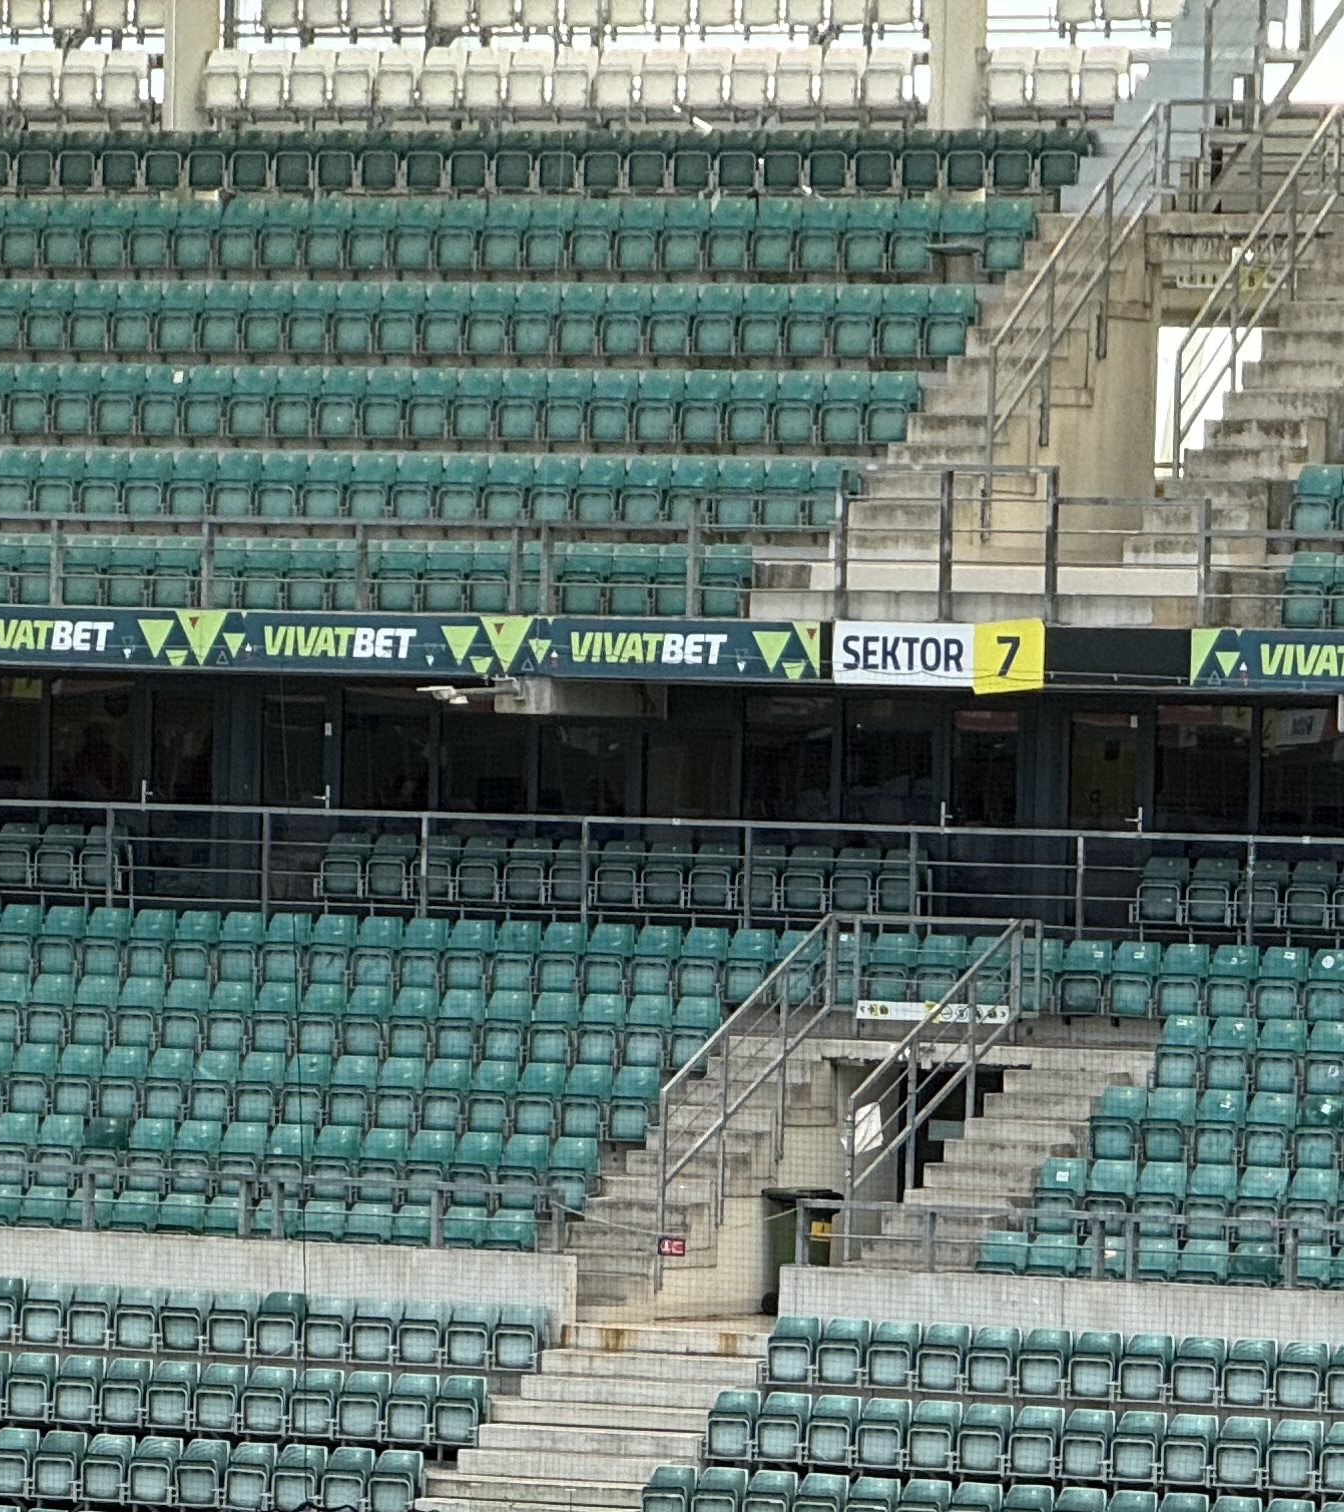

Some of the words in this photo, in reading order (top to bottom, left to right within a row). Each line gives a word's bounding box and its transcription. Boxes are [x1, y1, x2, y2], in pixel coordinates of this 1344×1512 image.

[263, 625, 418, 658] VIVATBET
[570, 631, 728, 665] VIVATBET
[842, 635, 965, 672] SEKTOR
[996, 635, 1021, 678] 7
